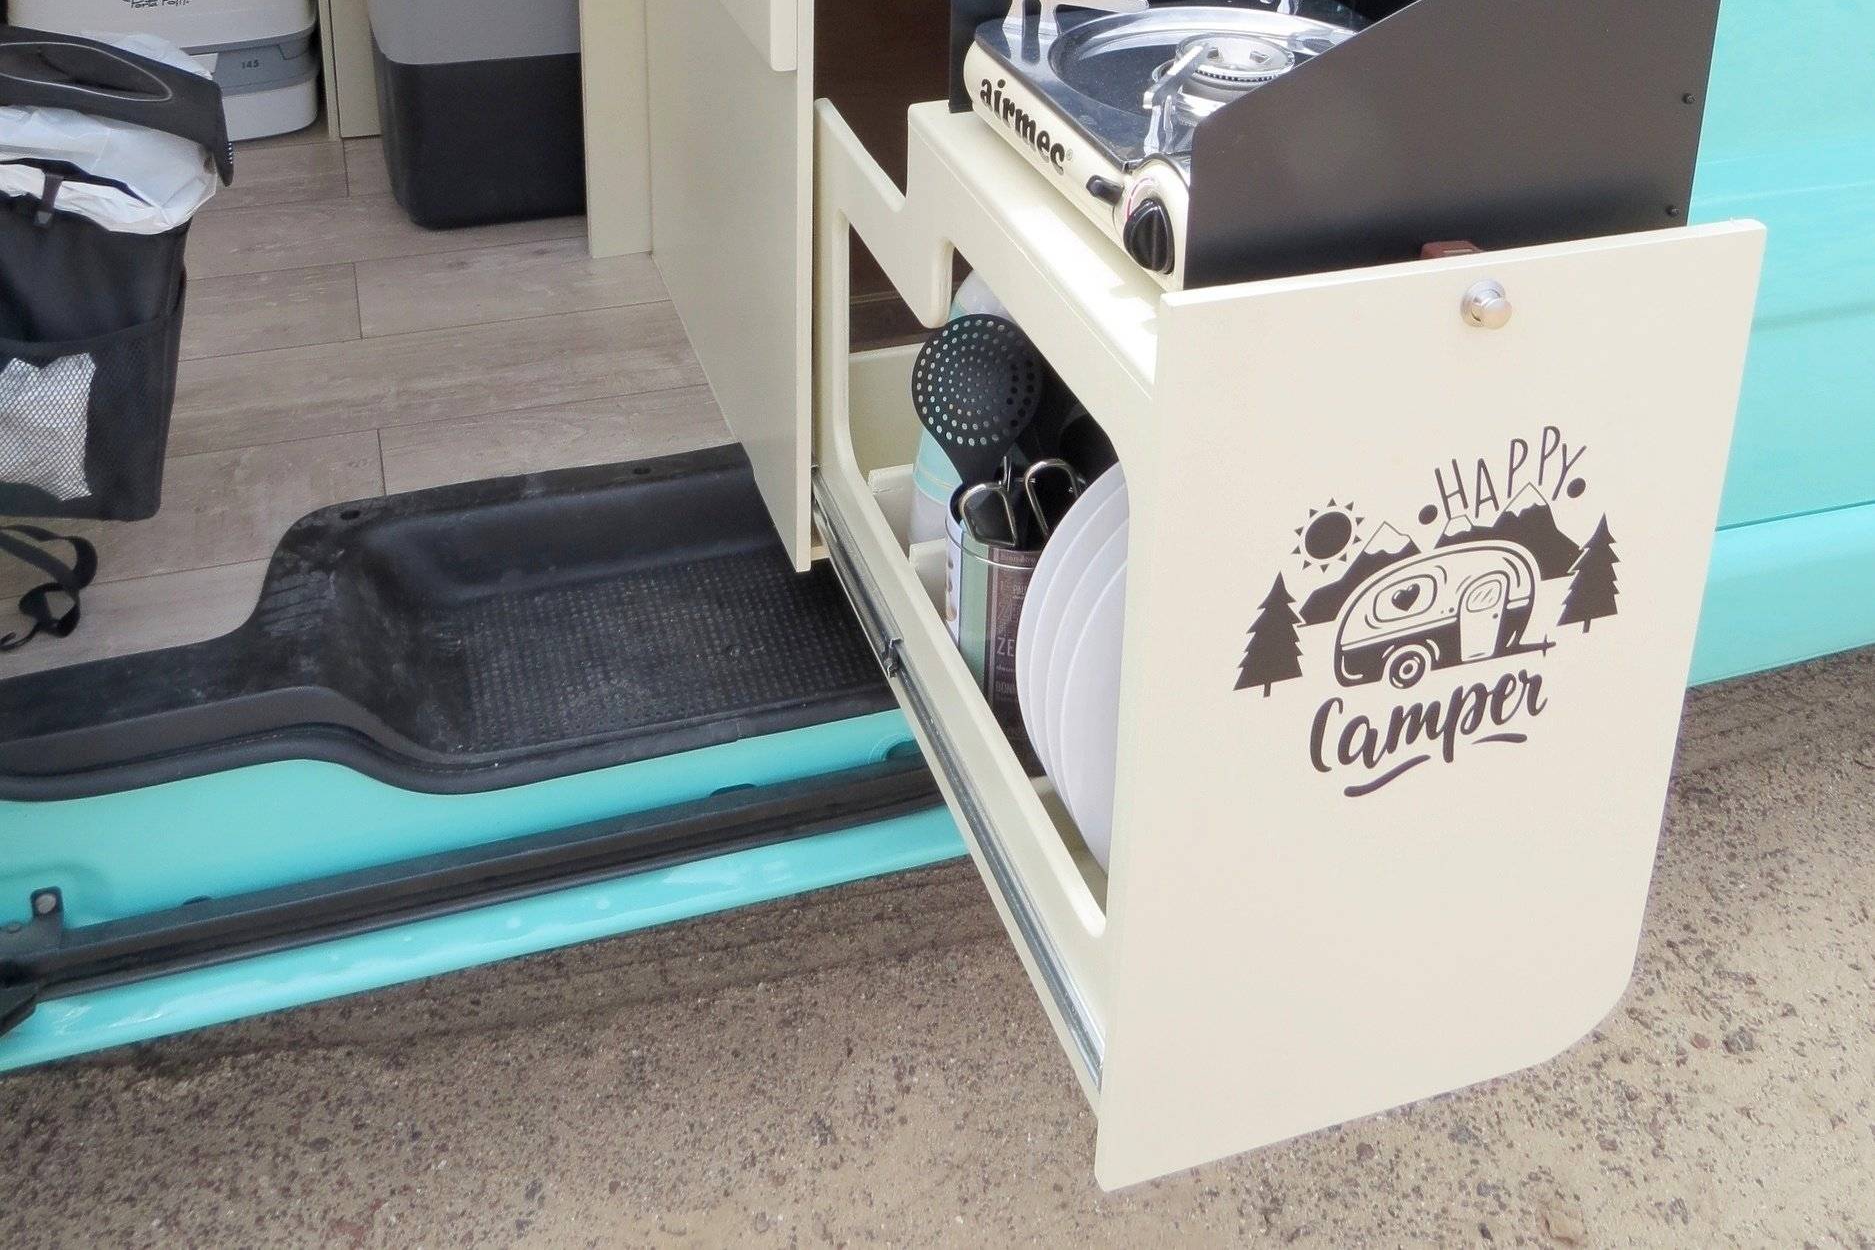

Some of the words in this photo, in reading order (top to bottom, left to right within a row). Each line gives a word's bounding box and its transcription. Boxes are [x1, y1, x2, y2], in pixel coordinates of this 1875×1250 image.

[979, 78, 1066, 175] airmec
[1433, 425, 1588, 519] HAPPY
[1309, 668, 1549, 773] Camper
